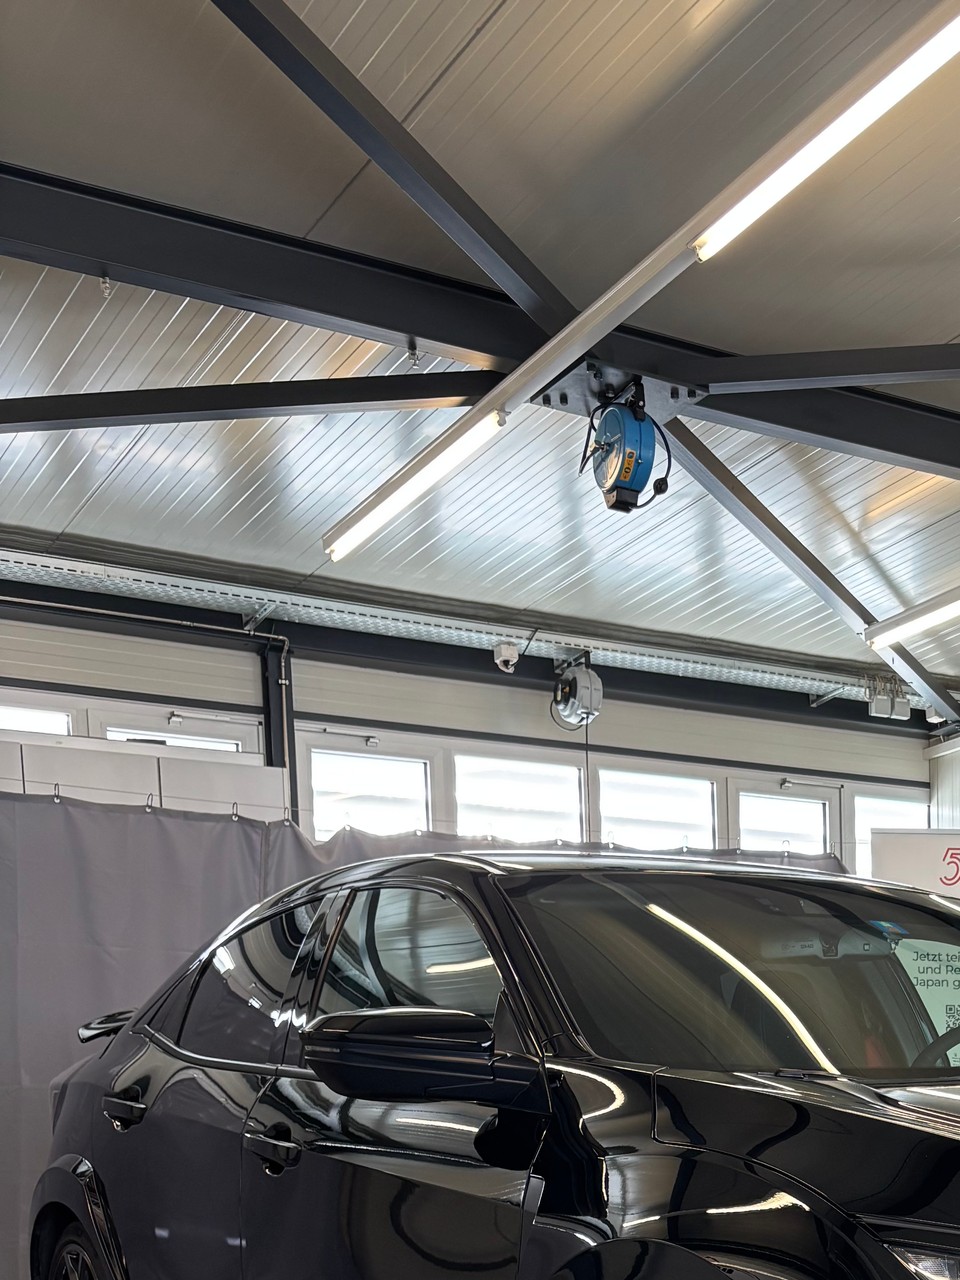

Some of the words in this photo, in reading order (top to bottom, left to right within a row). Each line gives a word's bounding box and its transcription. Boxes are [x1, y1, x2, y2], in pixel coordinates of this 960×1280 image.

[912, 951, 943, 962] Jetzt
[917, 964, 942, 975] und
[913, 977, 949, 989] Japan
